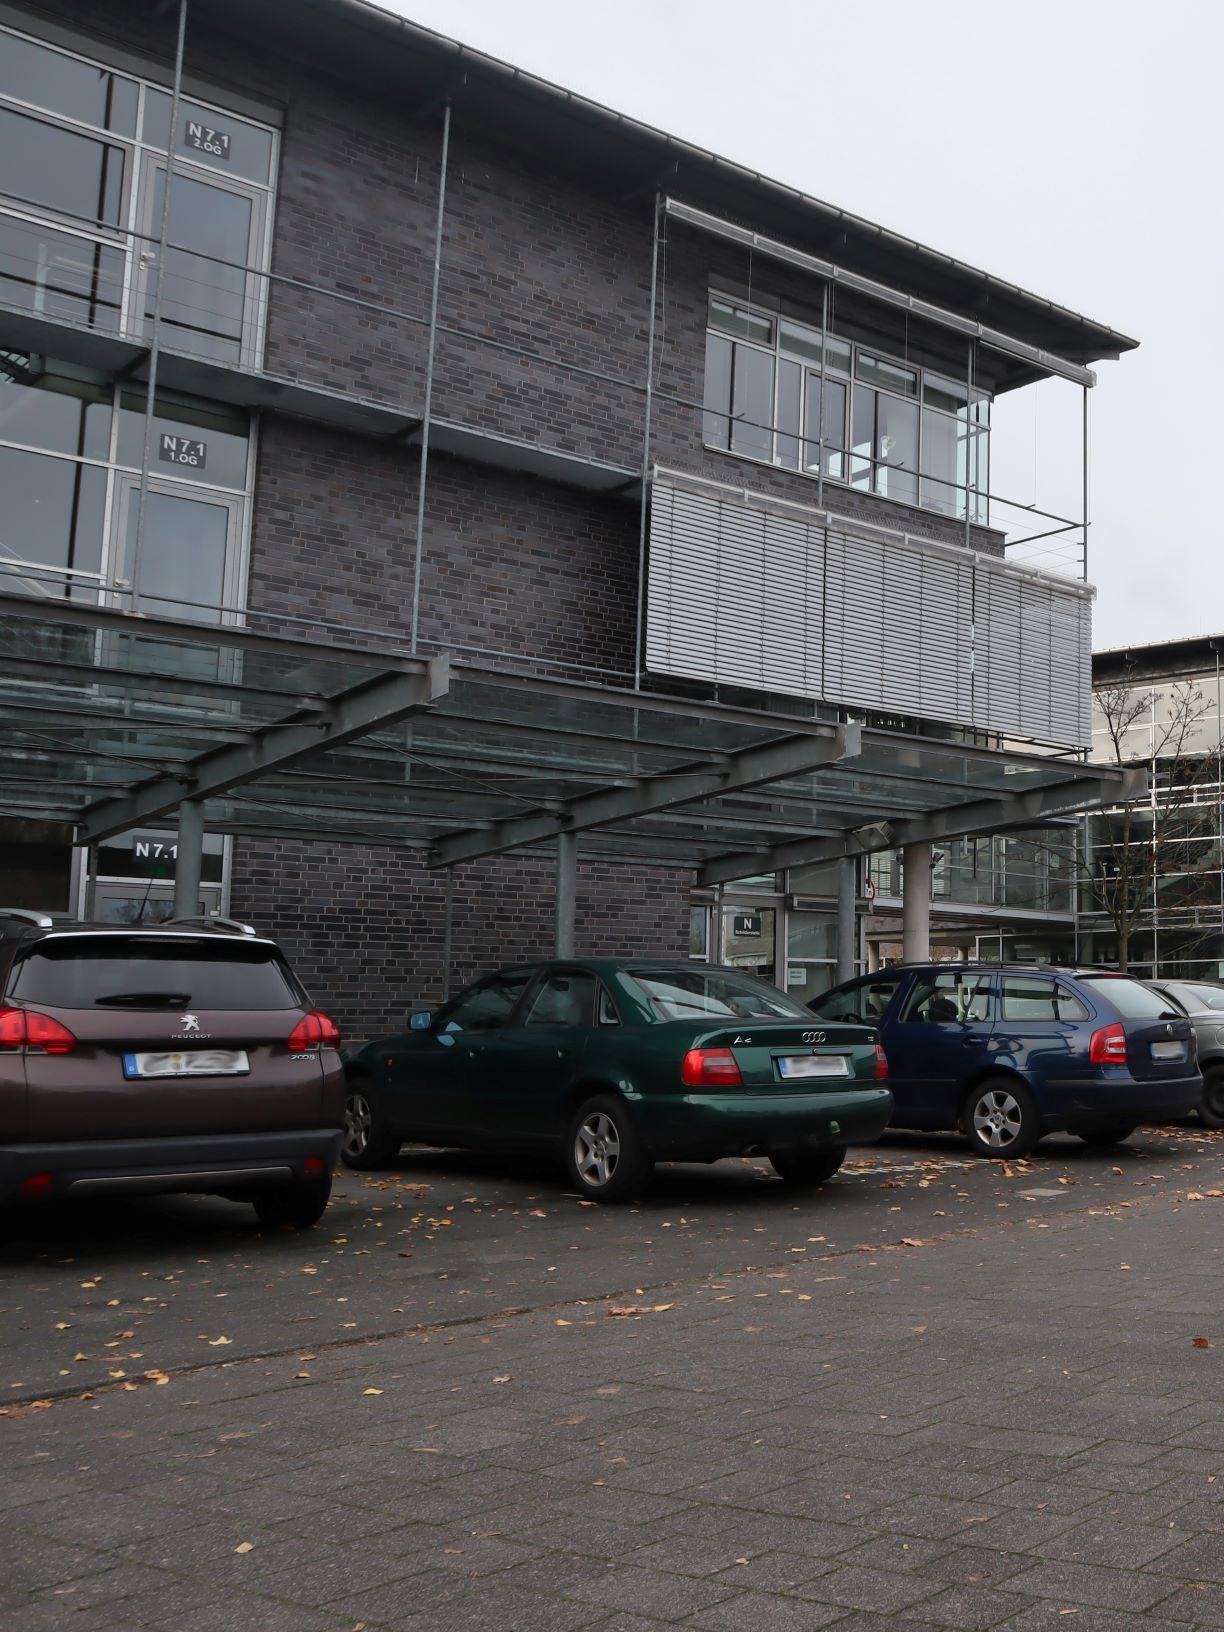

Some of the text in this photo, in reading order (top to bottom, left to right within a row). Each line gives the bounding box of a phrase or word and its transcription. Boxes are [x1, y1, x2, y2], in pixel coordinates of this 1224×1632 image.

[189, 122, 229, 148] N 7.1
[193, 138, 222, 155] 2.OG
[164, 435, 204, 457] N 7.1
[169, 451, 198, 465] 1.OG
[136, 842, 178, 859] N 7.1
[743, 918, 752, 929] N
